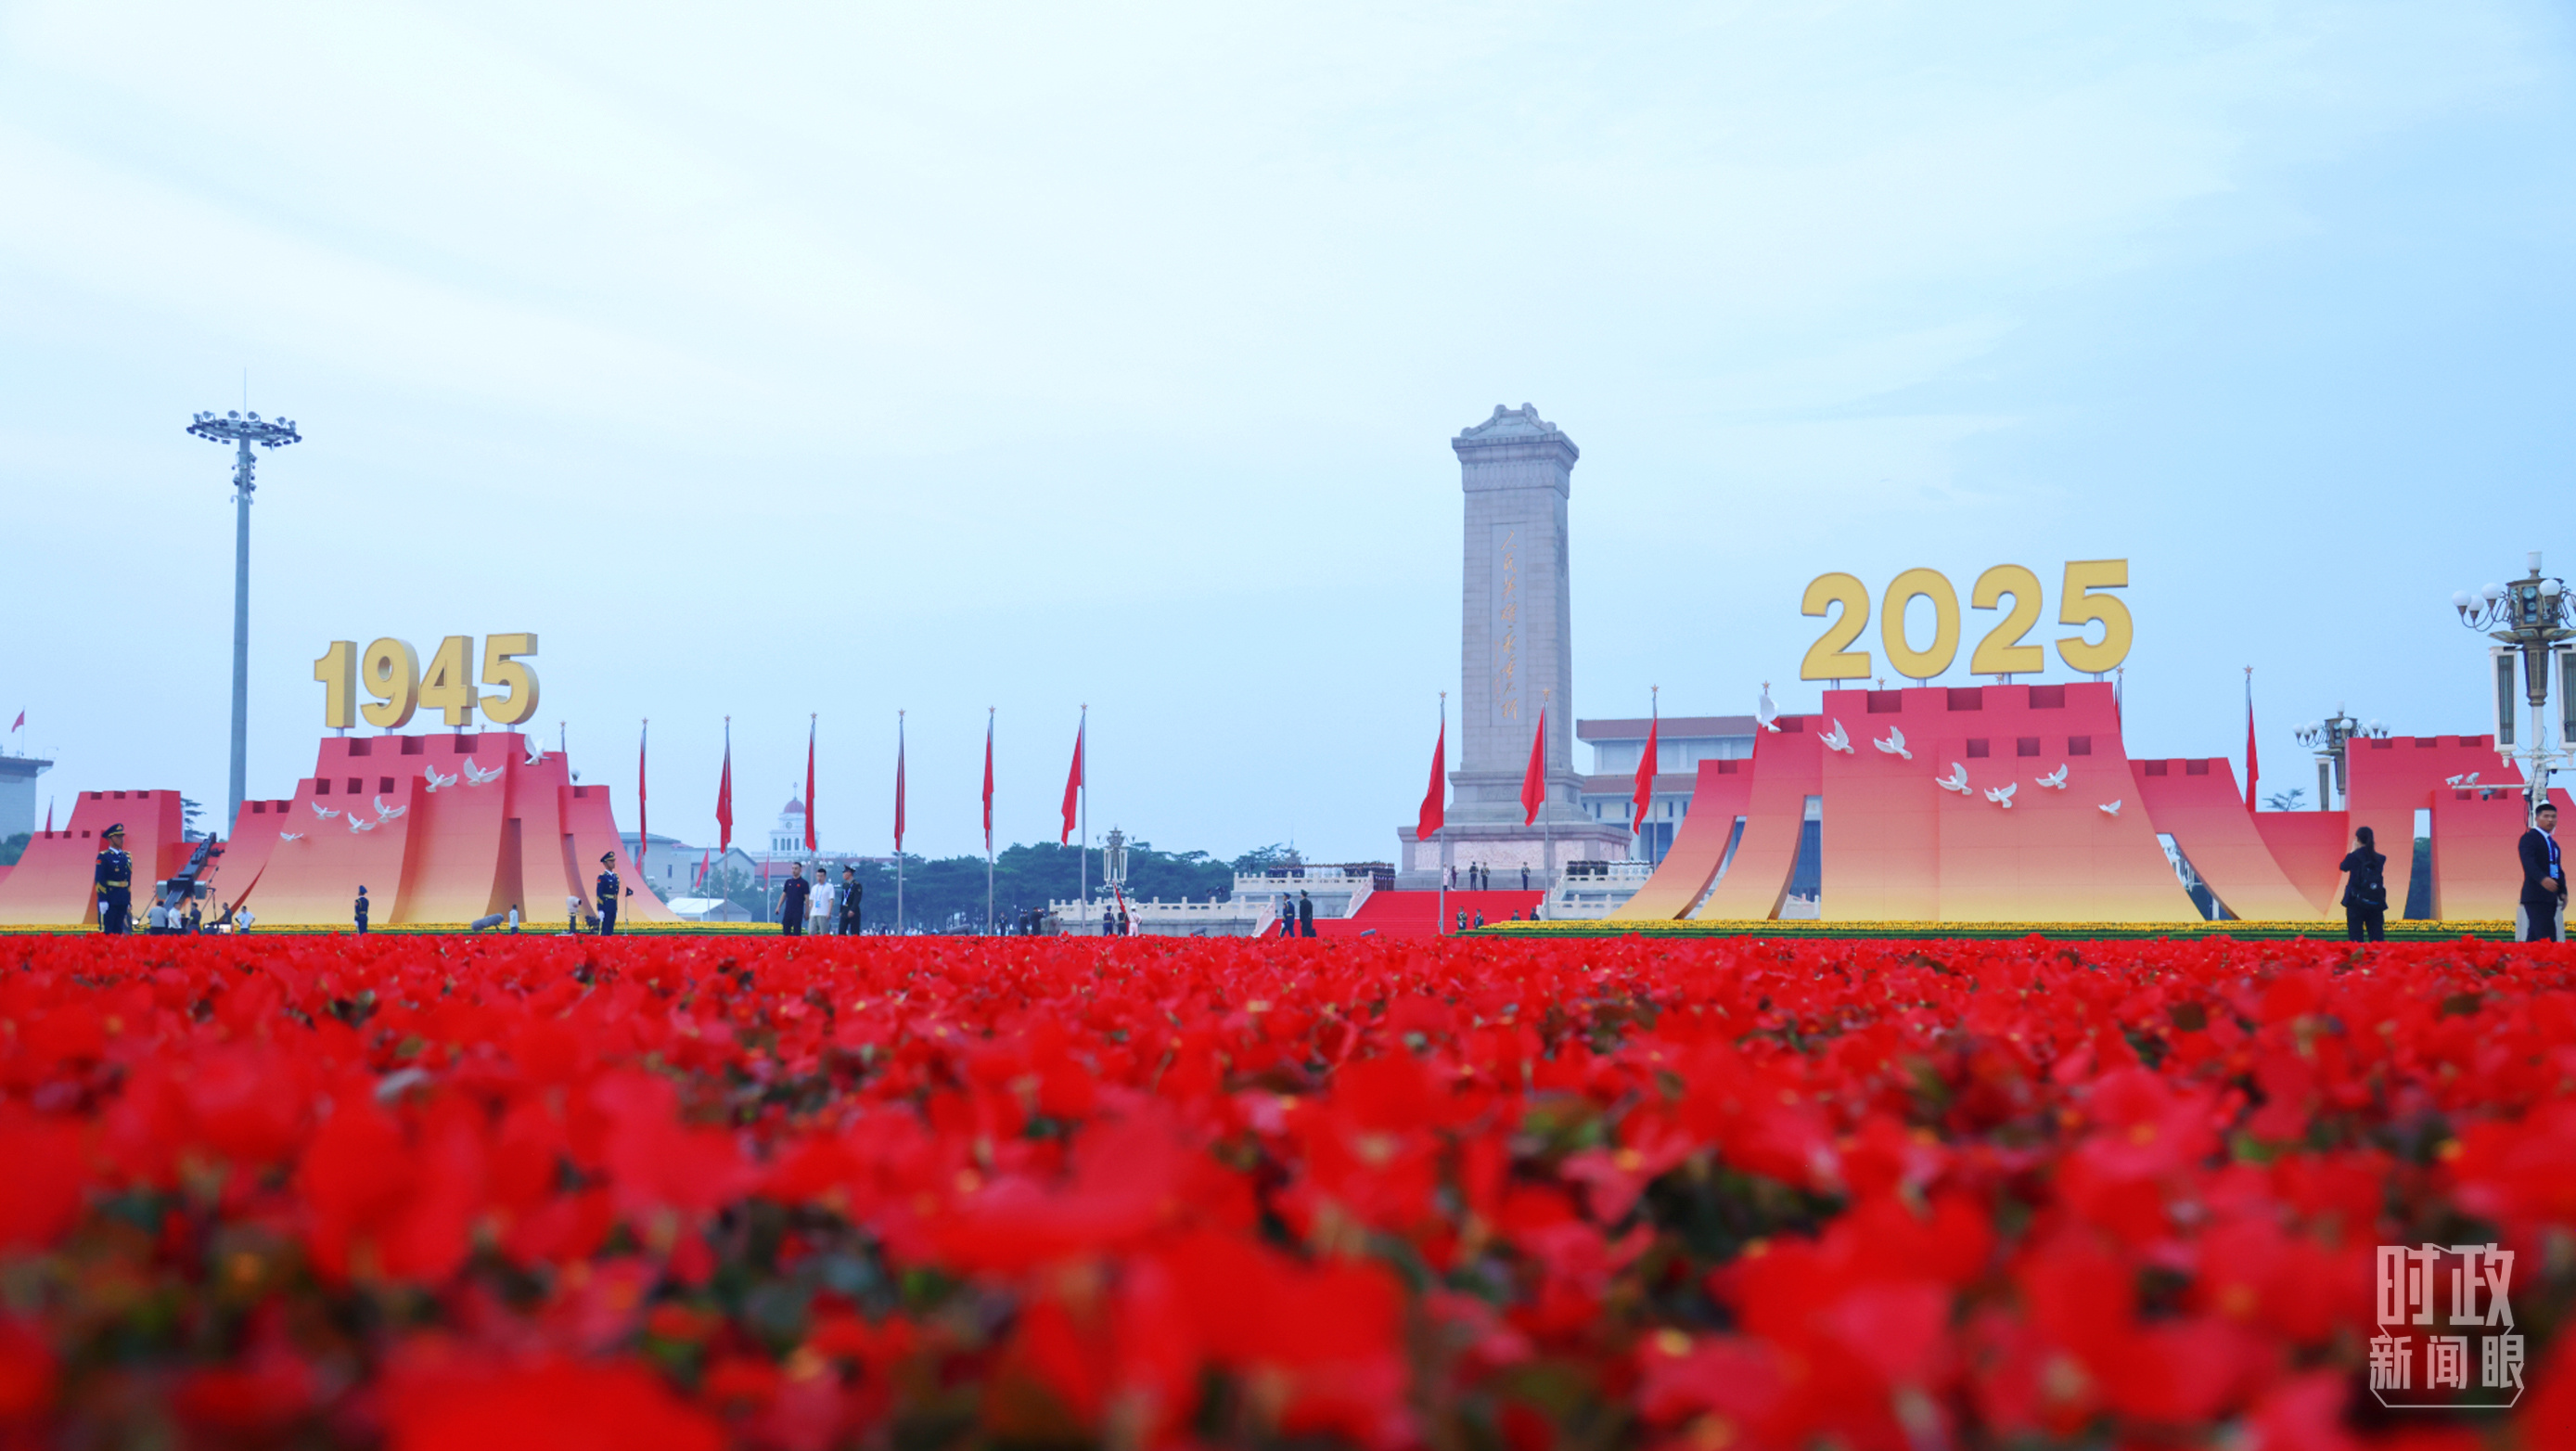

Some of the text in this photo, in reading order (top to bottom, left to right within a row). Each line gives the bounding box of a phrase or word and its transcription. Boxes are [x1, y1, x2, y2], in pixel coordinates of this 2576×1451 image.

[314, 632, 539, 729] 1945
[1501, 531, 1518, 720] 人民英雄永垂不朽
[1800, 558, 2134, 681] 2025
